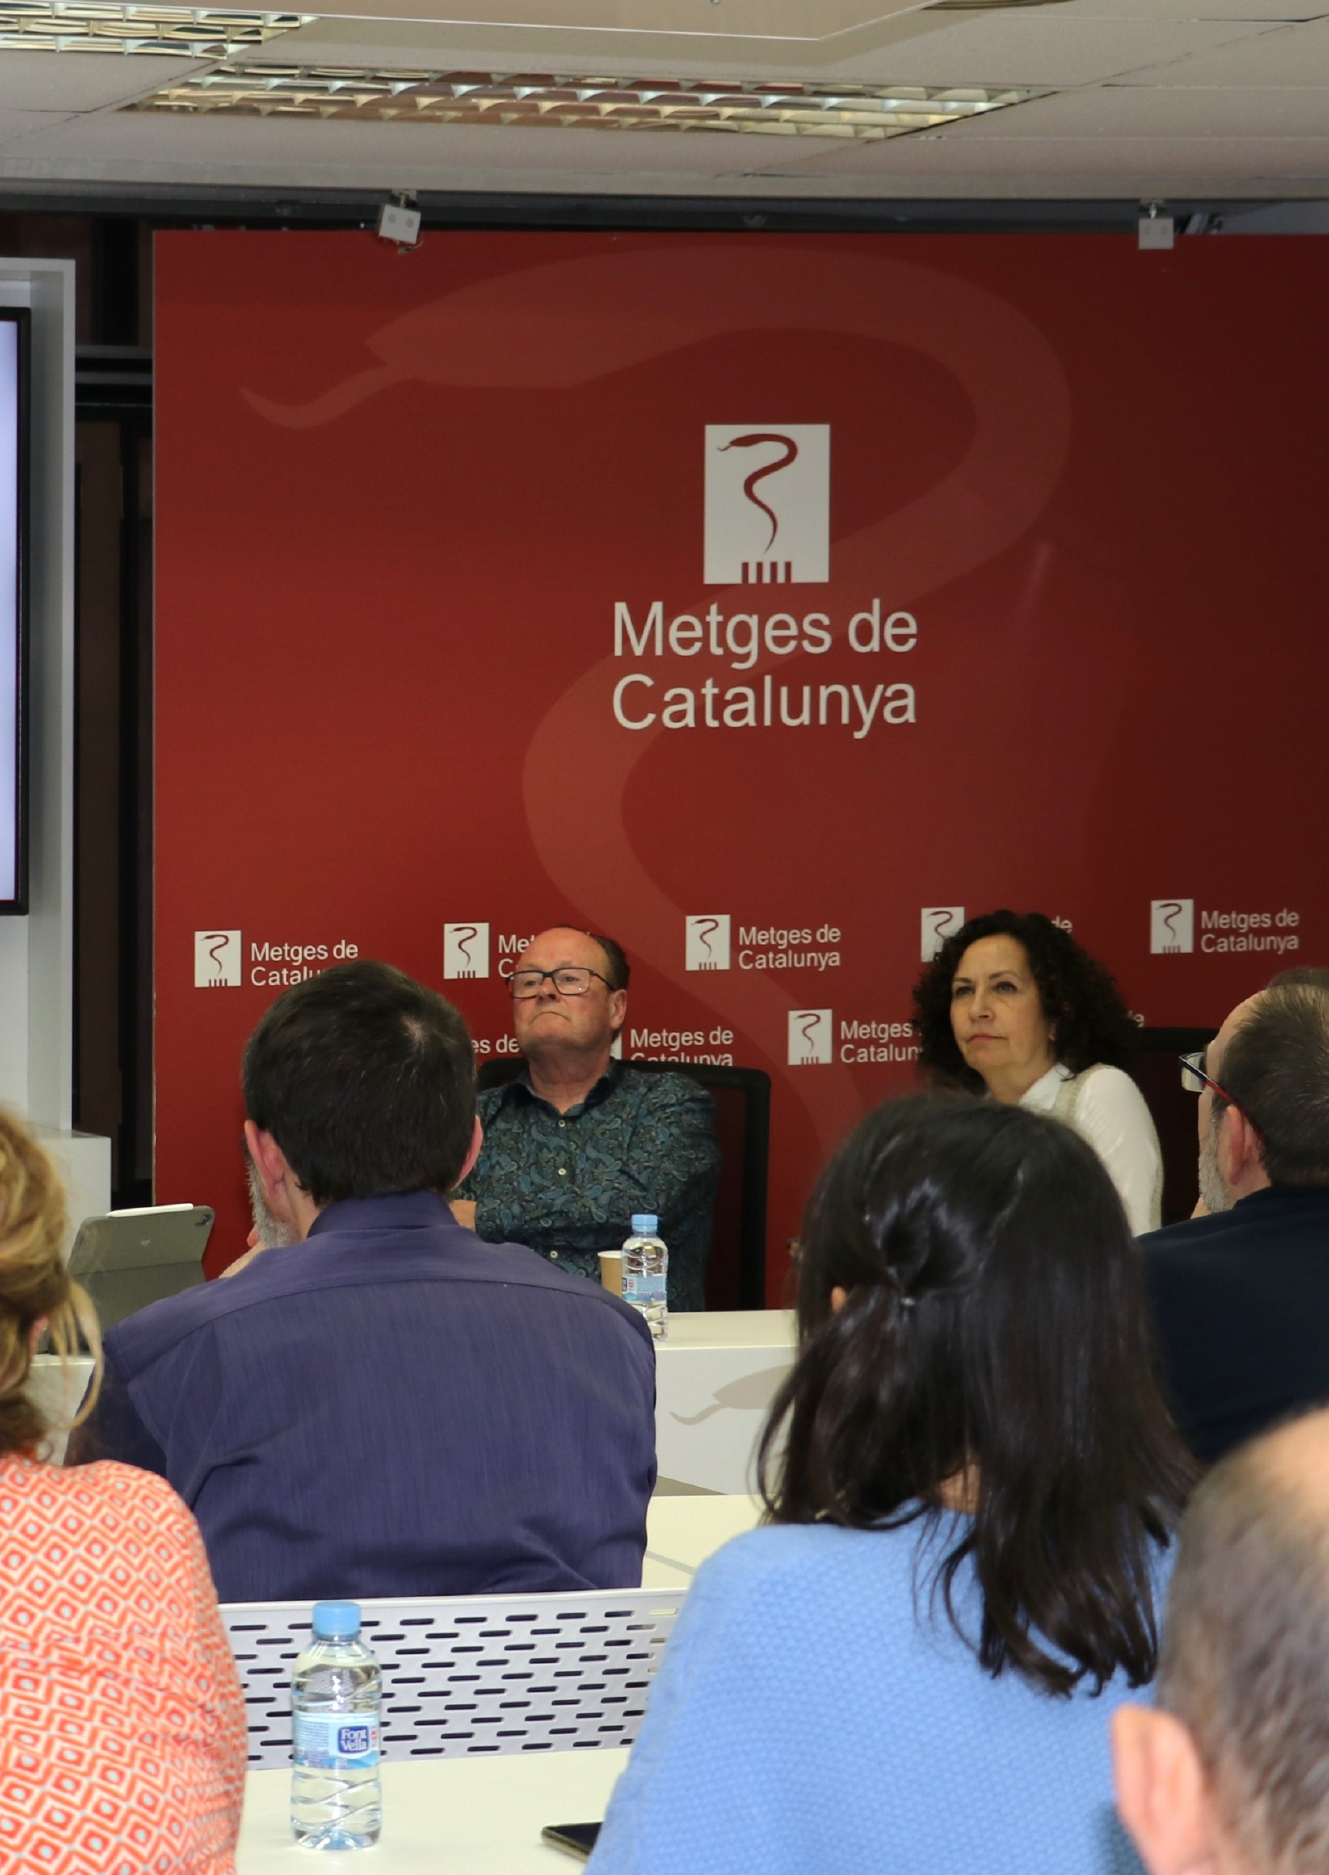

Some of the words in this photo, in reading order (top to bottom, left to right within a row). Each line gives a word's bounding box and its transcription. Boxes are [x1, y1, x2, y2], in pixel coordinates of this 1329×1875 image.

[614, 601, 831, 669] Metges
[848, 598, 917, 652] de
[613, 674, 915, 739] Catalunya
[1202, 911, 1271, 932] Metges
[1275, 909, 1299, 927] de
[739, 927, 812, 949] Metges
[816, 924, 841, 943] de
[1201, 933, 1299, 954] Catalunya
[251, 942, 328, 965] Metges
[333, 940, 358, 959] de
[739, 949, 841, 971] Catalunya
[251, 966, 321, 986] Catal
[630, 1028, 705, 1051] Metges
[709, 1026, 733, 1045] de
[841, 1020, 913, 1043] Metges
[840, 1044, 922, 1064] Catalun
[341, 1728, 367, 1740] Font
[341, 1739, 367, 1751] Vella
